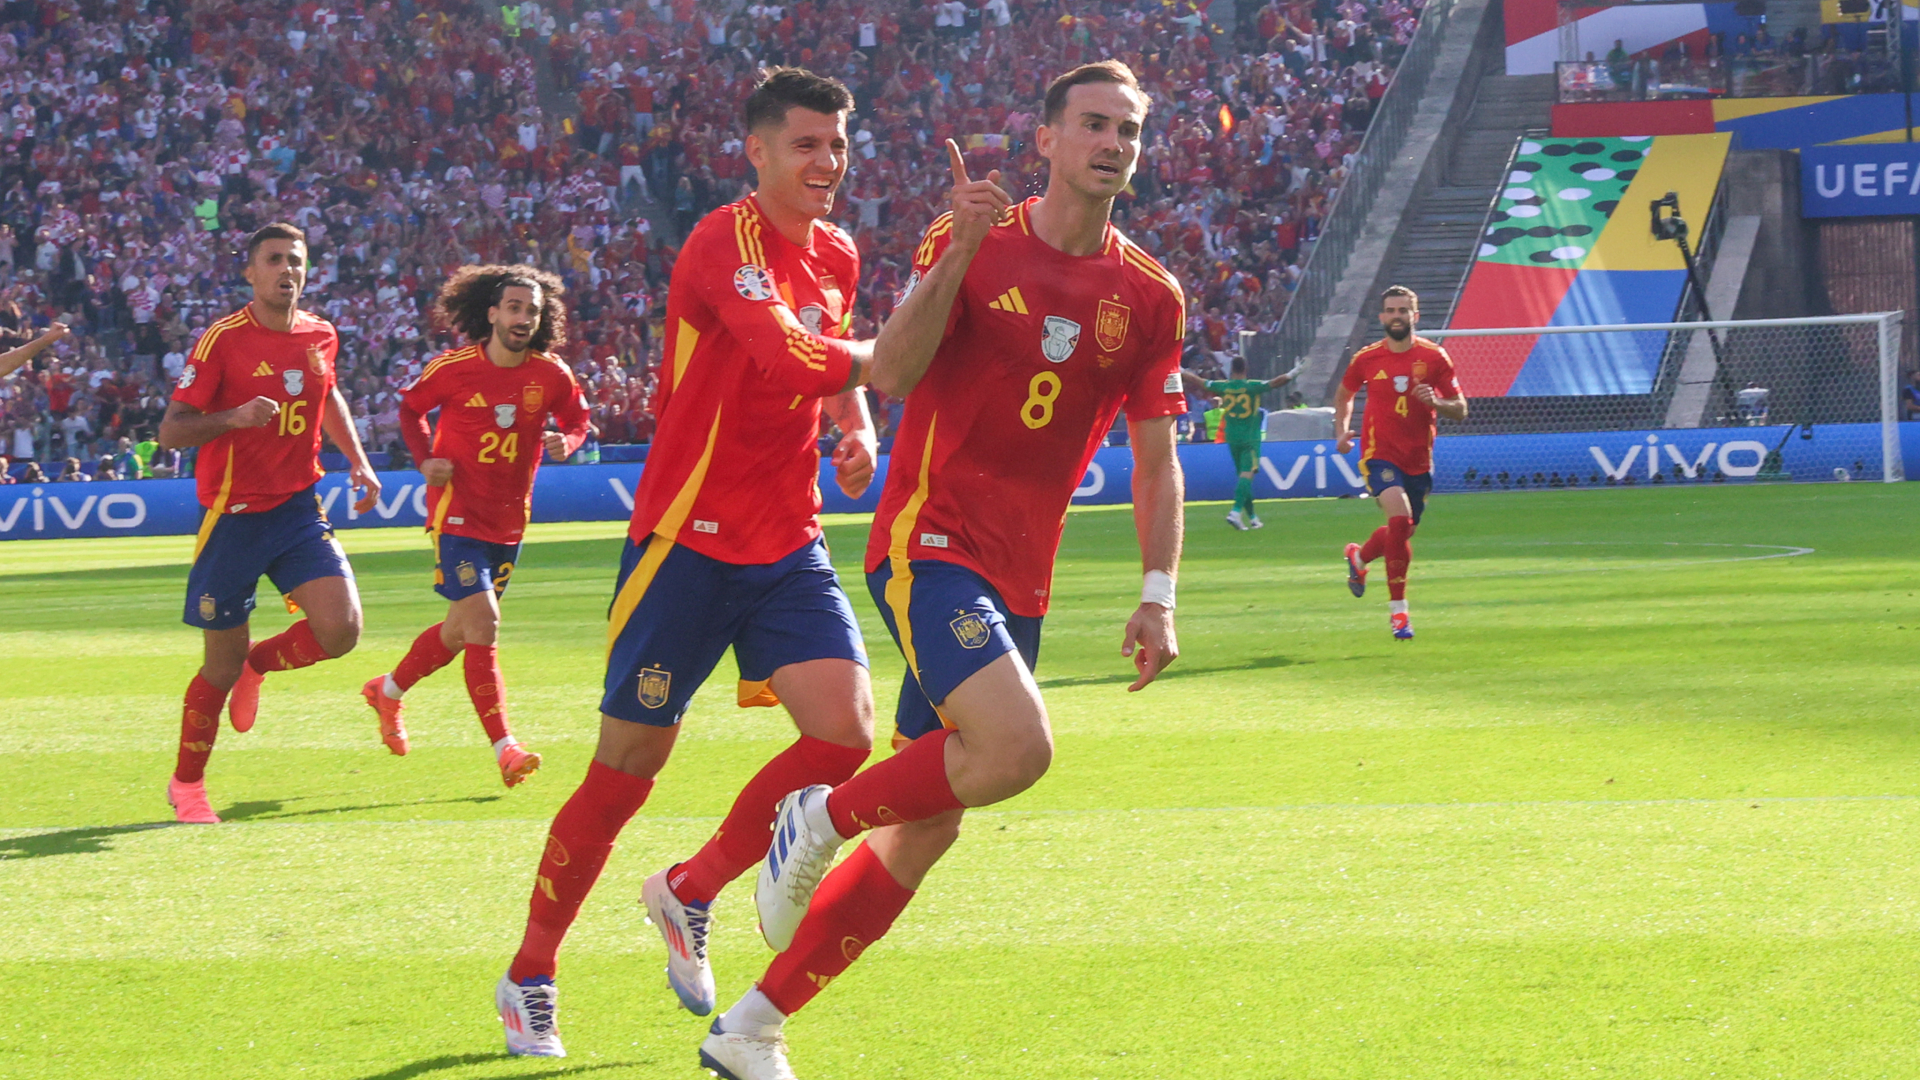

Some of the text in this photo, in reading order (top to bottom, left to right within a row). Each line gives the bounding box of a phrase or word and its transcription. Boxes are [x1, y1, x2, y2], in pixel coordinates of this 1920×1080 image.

[279, 400, 307, 436] 16
[1020, 371, 1062, 430] 8
[1223, 393, 1253, 419] 23
[1395, 396, 1409, 418] 4
[478, 431, 519, 464] 24
[1588, 434, 1768, 480] vivo
[1260, 444, 1366, 490] viv
